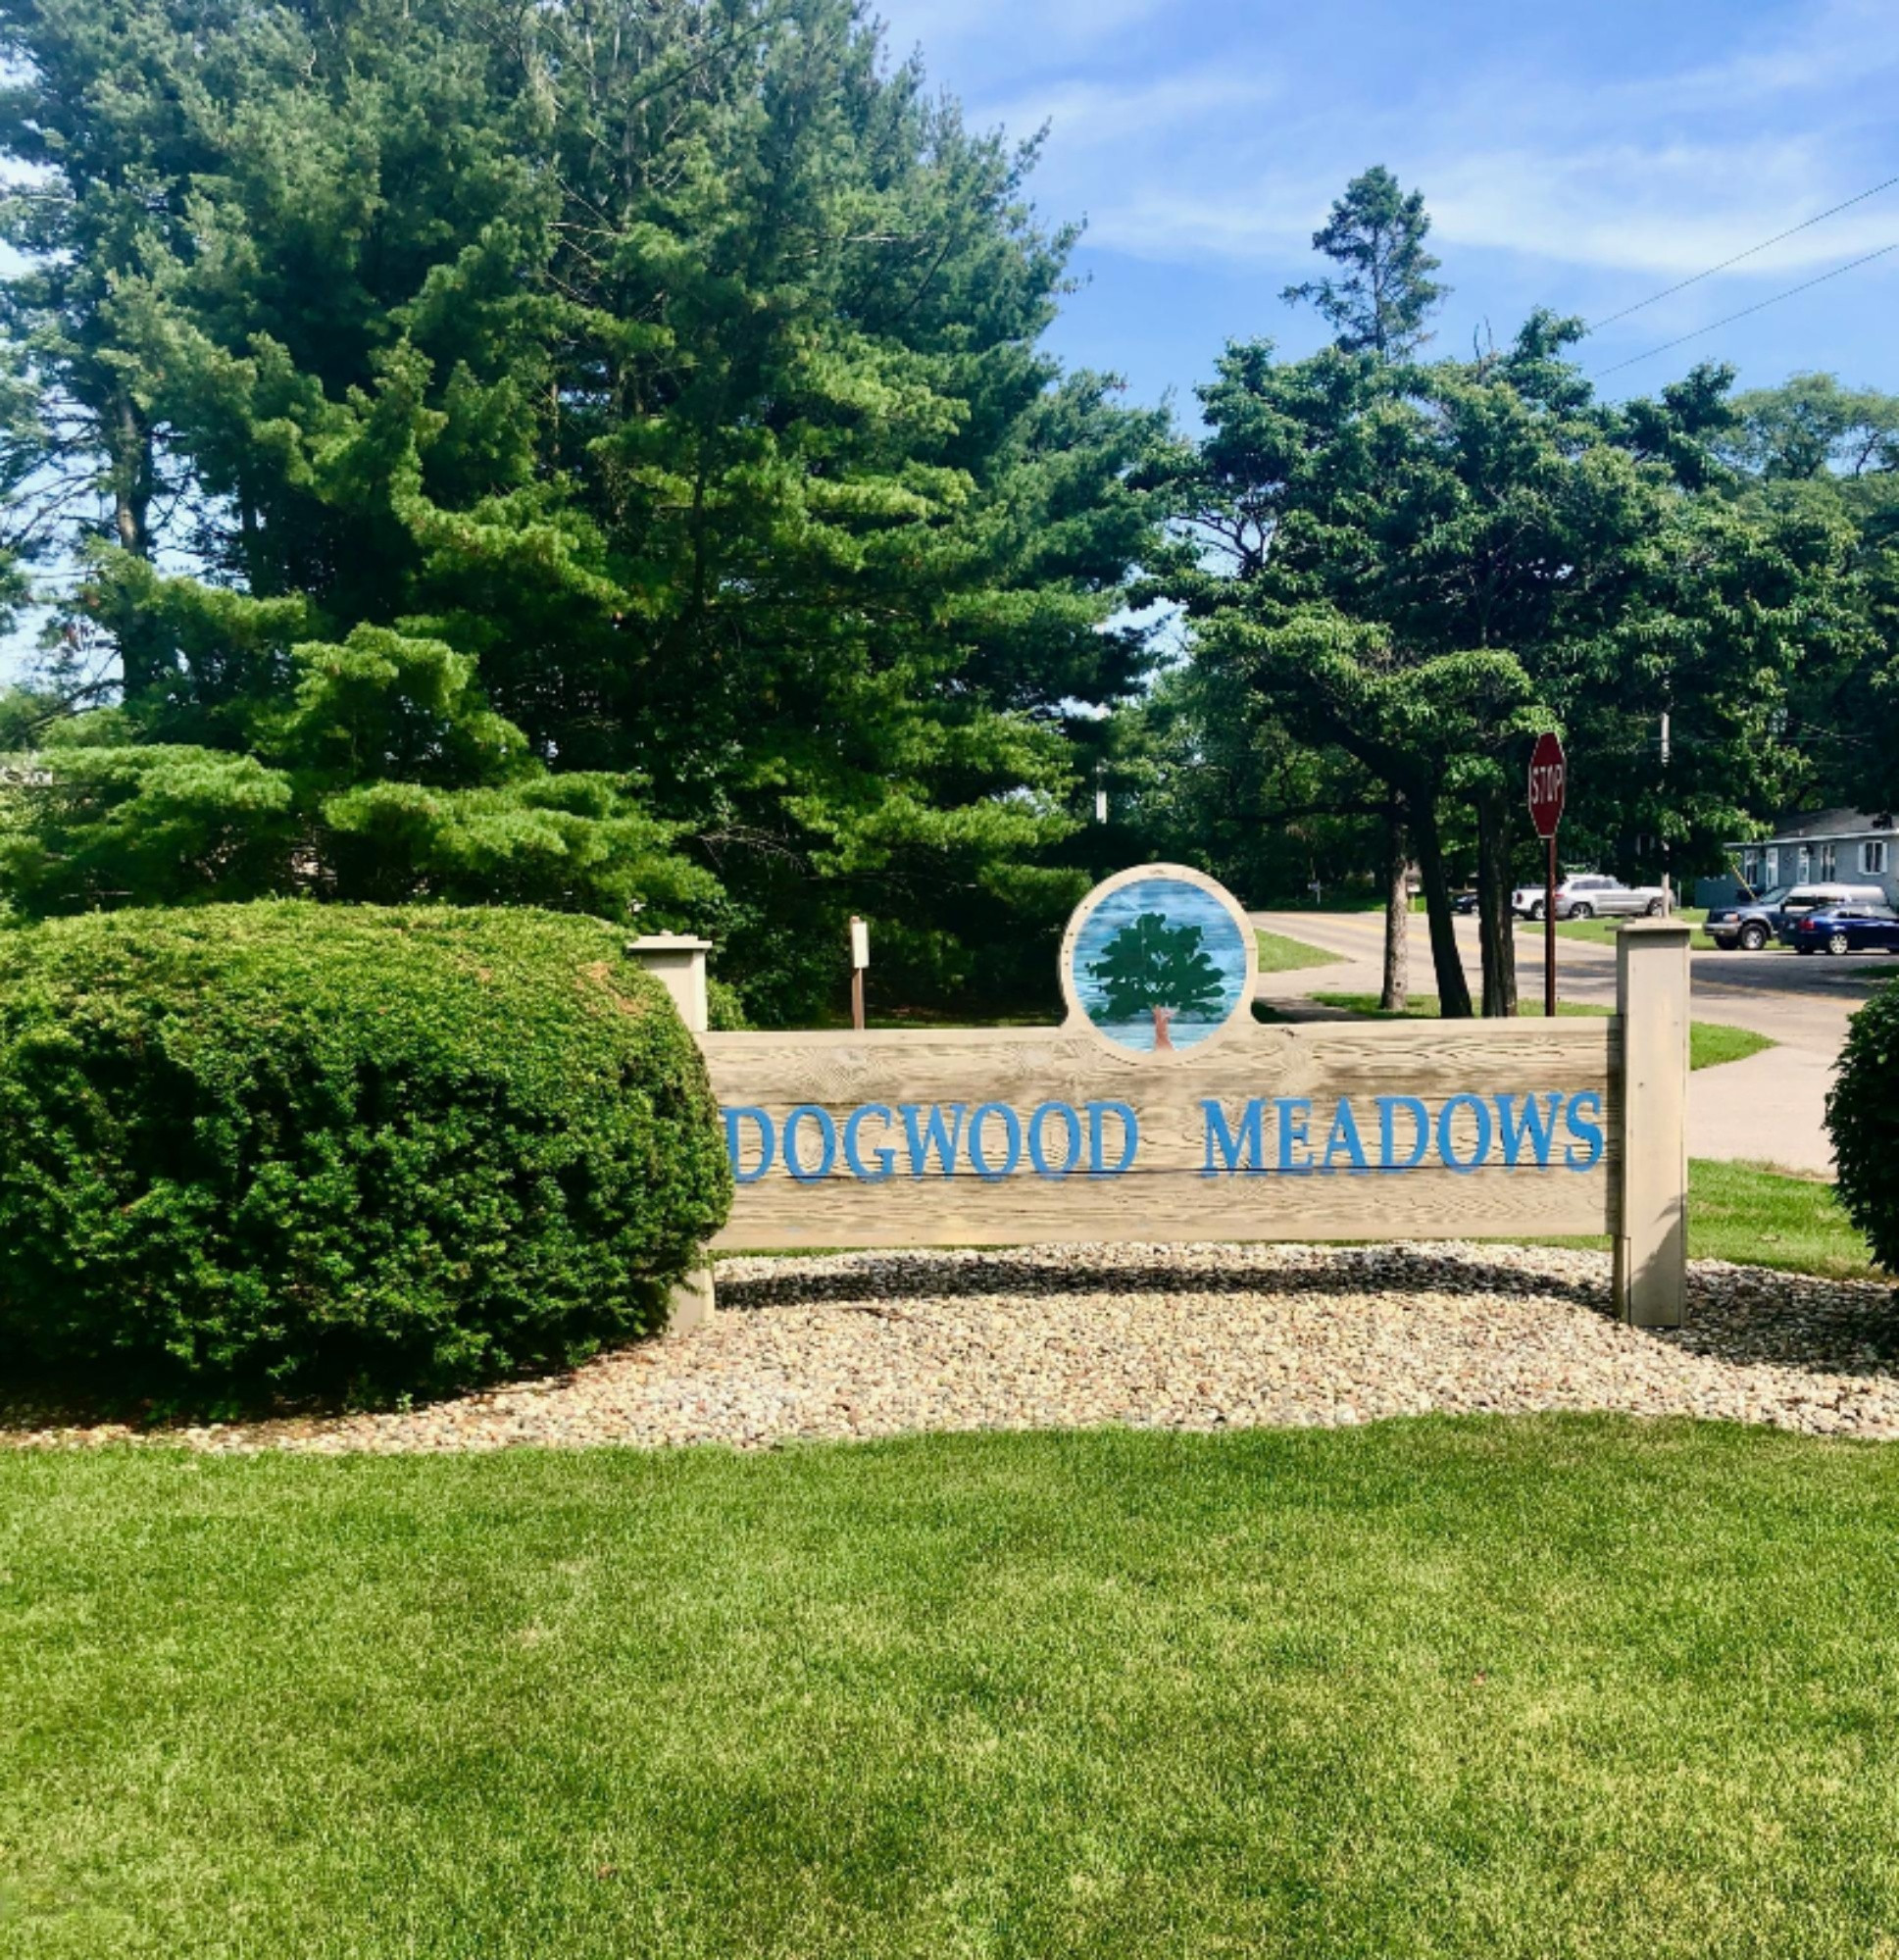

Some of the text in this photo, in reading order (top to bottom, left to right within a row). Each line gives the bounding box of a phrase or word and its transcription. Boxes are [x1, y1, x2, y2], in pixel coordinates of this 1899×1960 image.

[1531, 764, 1563, 804] STOP
[721, 1090, 1605, 1183] DOGWOOD MEADOWS
